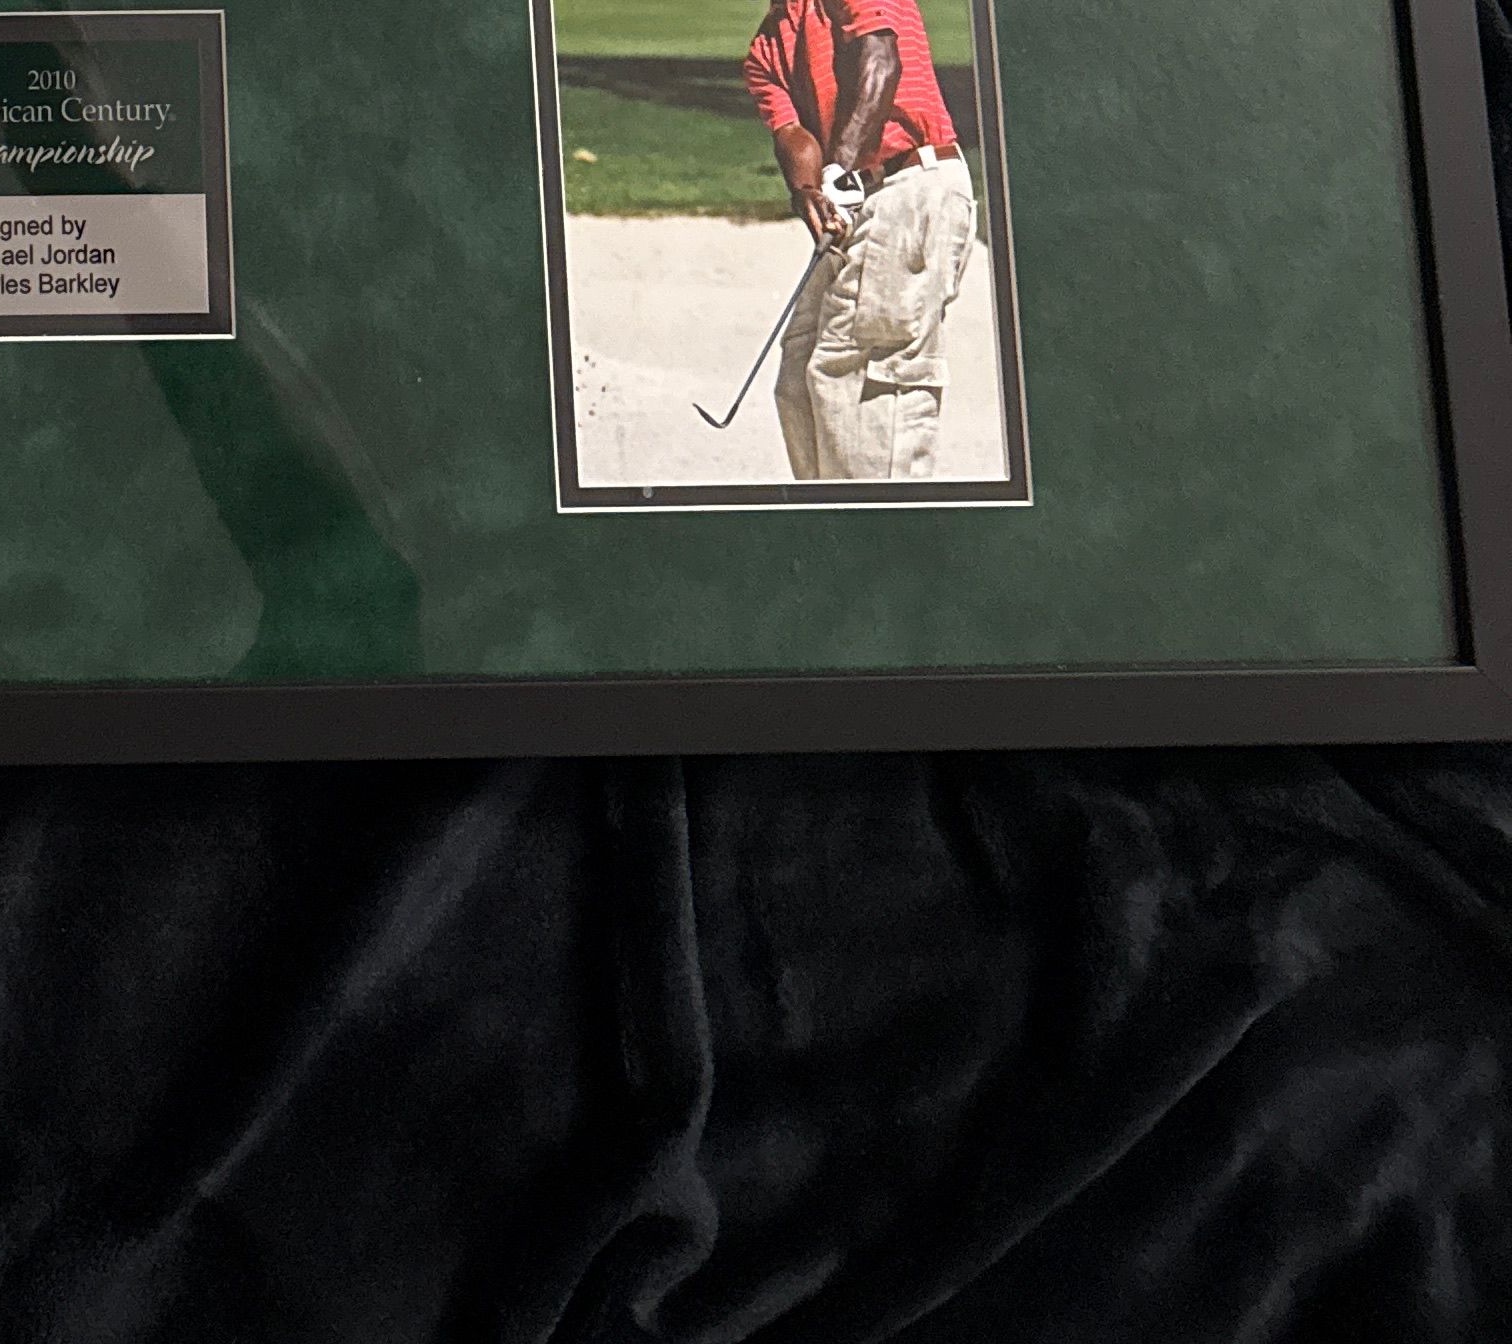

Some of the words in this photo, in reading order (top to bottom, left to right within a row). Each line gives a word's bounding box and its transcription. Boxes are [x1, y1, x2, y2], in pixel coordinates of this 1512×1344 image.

[27, 69, 77, 91] 2010
[61, 96, 172, 130] Century
[61, 215, 87, 241] by
[41, 243, 116, 266] Jordan
[38, 272, 120, 299] Barkley
